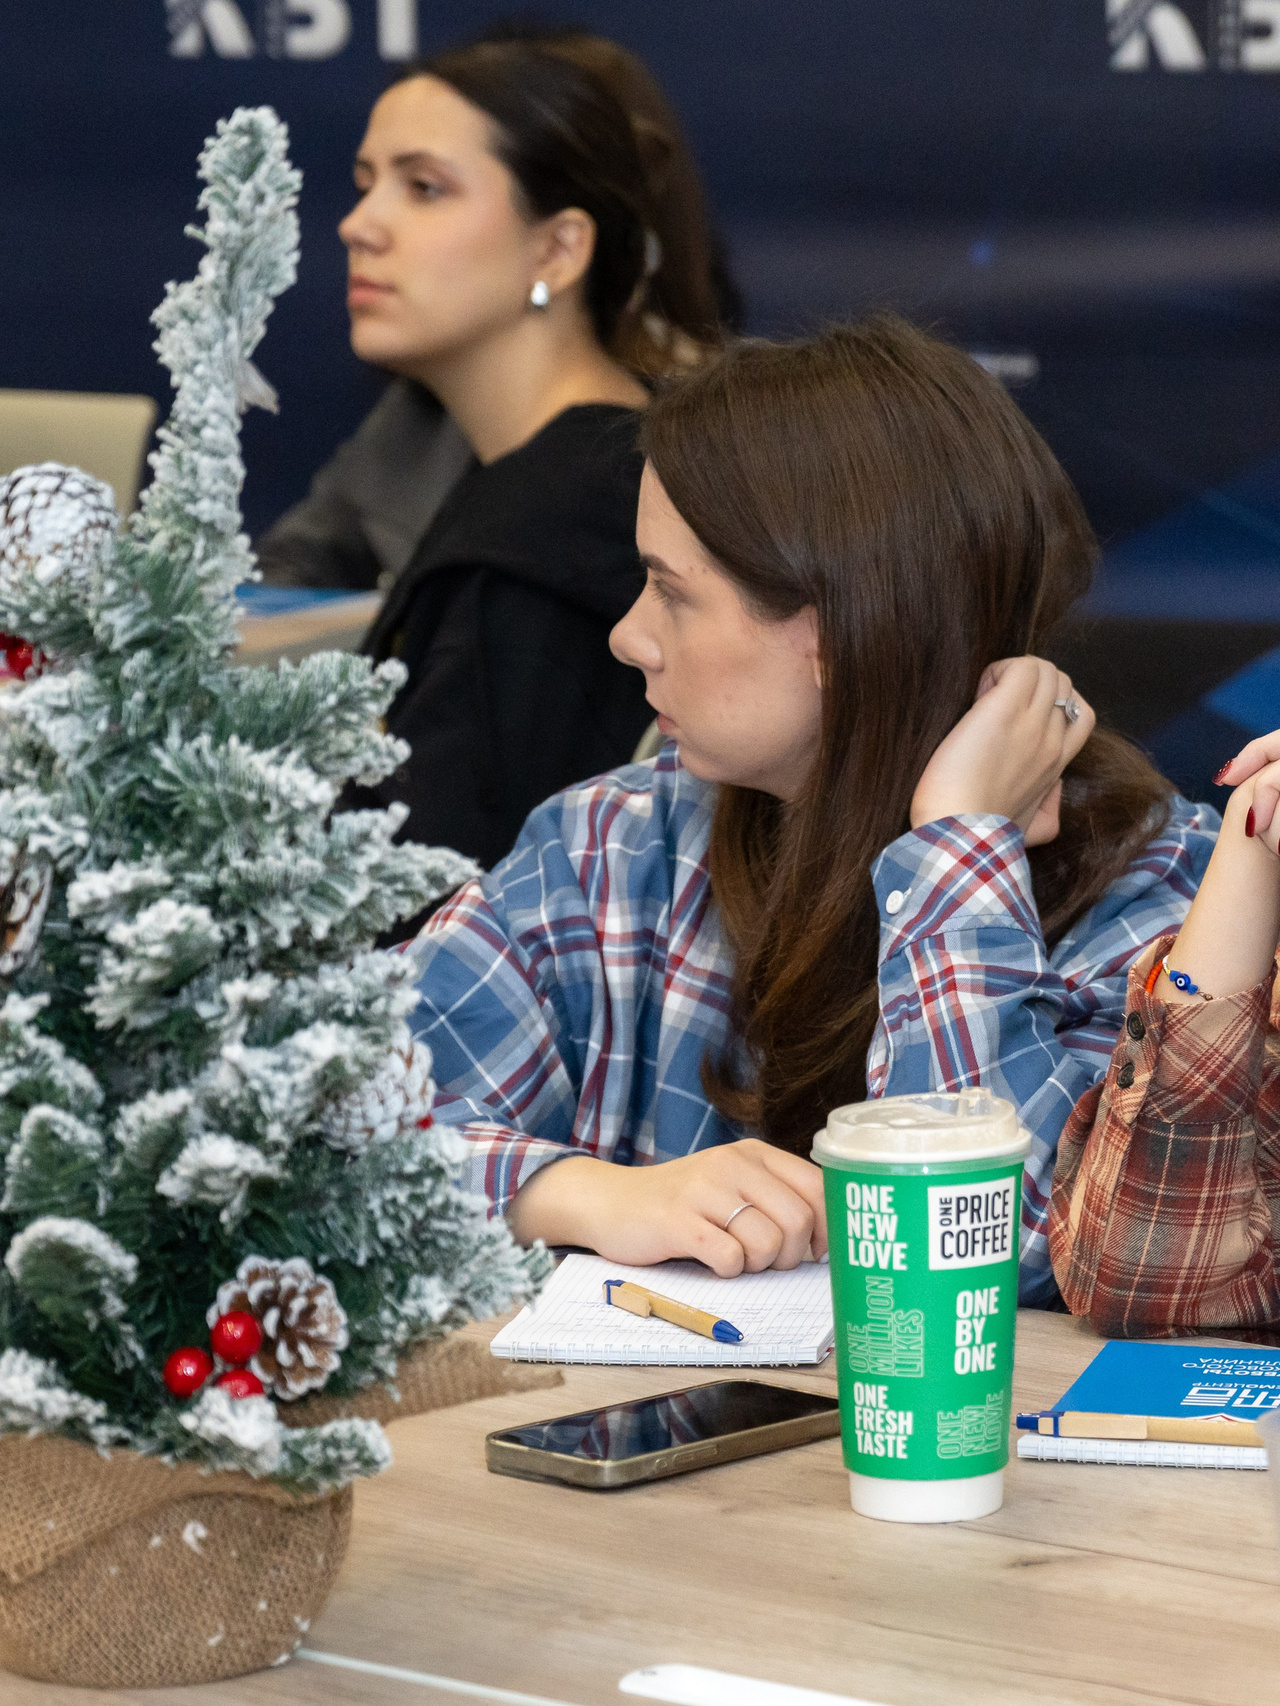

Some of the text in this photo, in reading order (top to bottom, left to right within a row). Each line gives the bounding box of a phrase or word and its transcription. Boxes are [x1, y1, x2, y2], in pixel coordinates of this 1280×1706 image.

[845, 1181, 895, 1214] ONE
[939, 1196, 953, 1227] ONE
[955, 1188, 1010, 1226] PRICE
[846, 1210, 898, 1242] NEW
[941, 1222, 1009, 1260] COFFEE
[848, 1238, 908, 1271] LOVE
[956, 1285, 1000, 1319] ONE
[865, 1275, 894, 1376] MILLION
[955, 1316, 986, 1347] BY
[847, 1321, 869, 1373] ONE
[894, 1309, 924, 1378] LIKES
[954, 1342, 997, 1375] ONE
[853, 1382, 888, 1410] ONE
[854, 1405, 913, 1435] FRESH
[937, 1410, 963, 1459] ONE
[962, 1405, 986, 1457] NEW
[984, 1390, 1004, 1452] LOVE
[855, 1430, 908, 1459] TASTE
